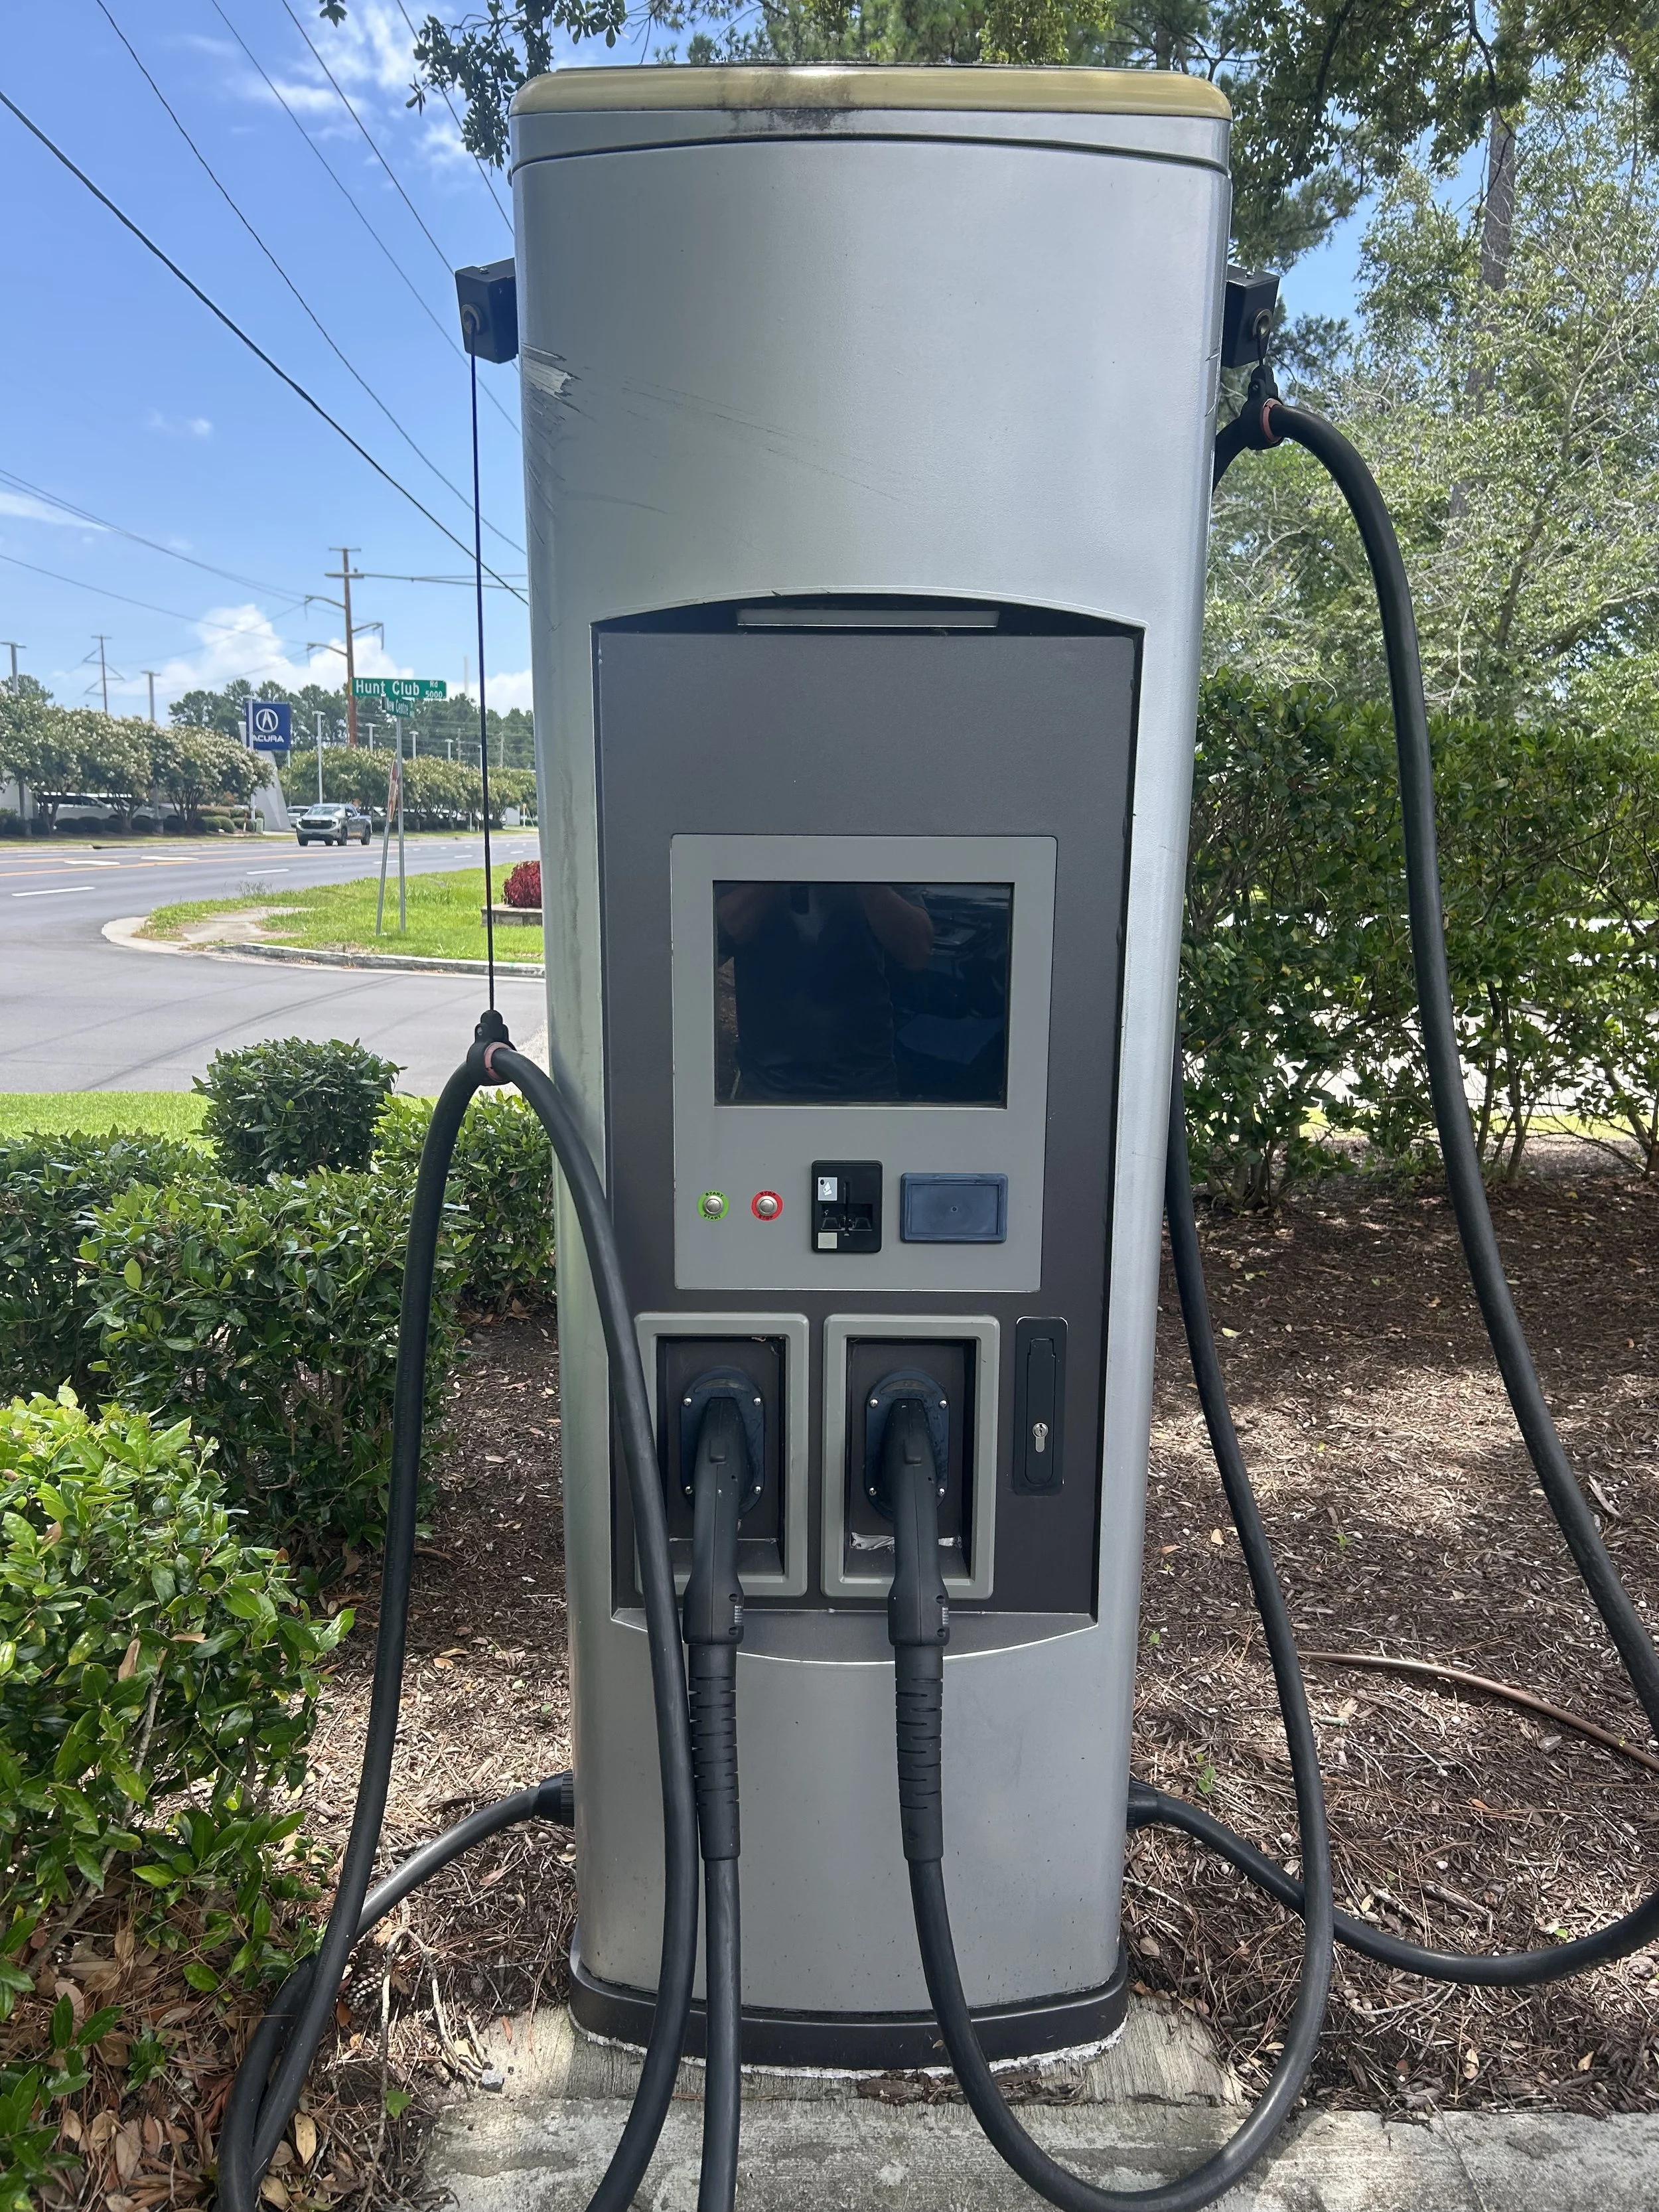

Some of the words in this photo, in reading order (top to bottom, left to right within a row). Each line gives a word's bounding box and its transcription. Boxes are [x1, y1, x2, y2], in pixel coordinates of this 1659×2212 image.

[356, 680, 386, 694] Hunt
[392, 680, 420, 696] Club
[425, 690, 443, 699] 5000
[252, 734, 285, 743] ACURA
